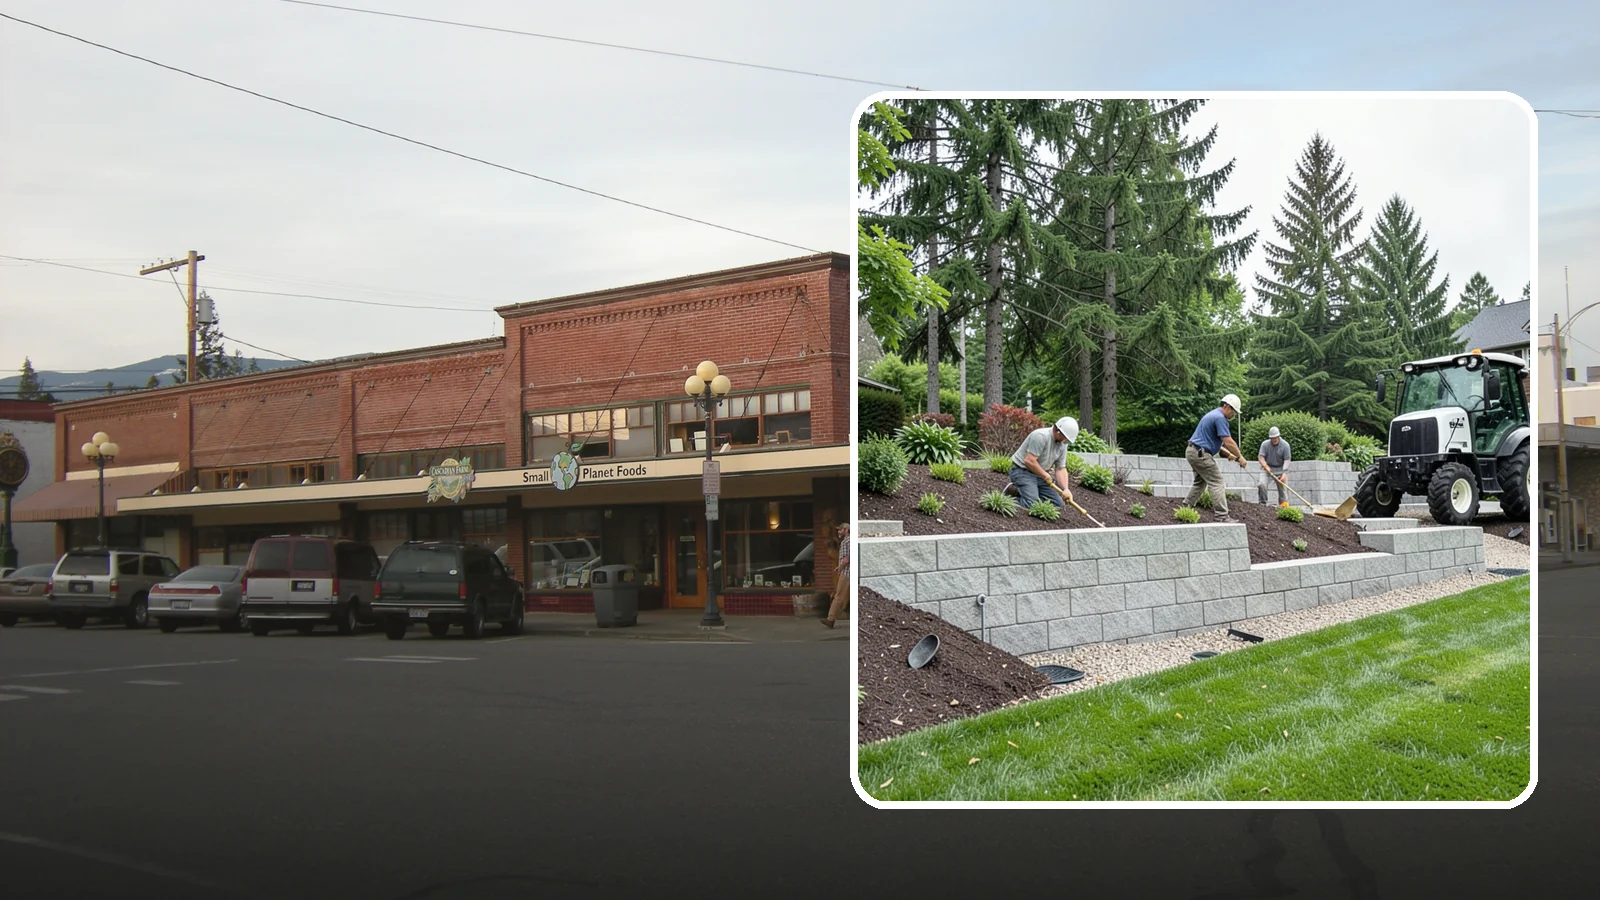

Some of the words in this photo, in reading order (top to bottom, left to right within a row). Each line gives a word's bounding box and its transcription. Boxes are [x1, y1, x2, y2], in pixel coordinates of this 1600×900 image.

[523, 471, 549, 483] Small
[583, 468, 614, 479] Planet
[617, 464, 647, 477] Foods
